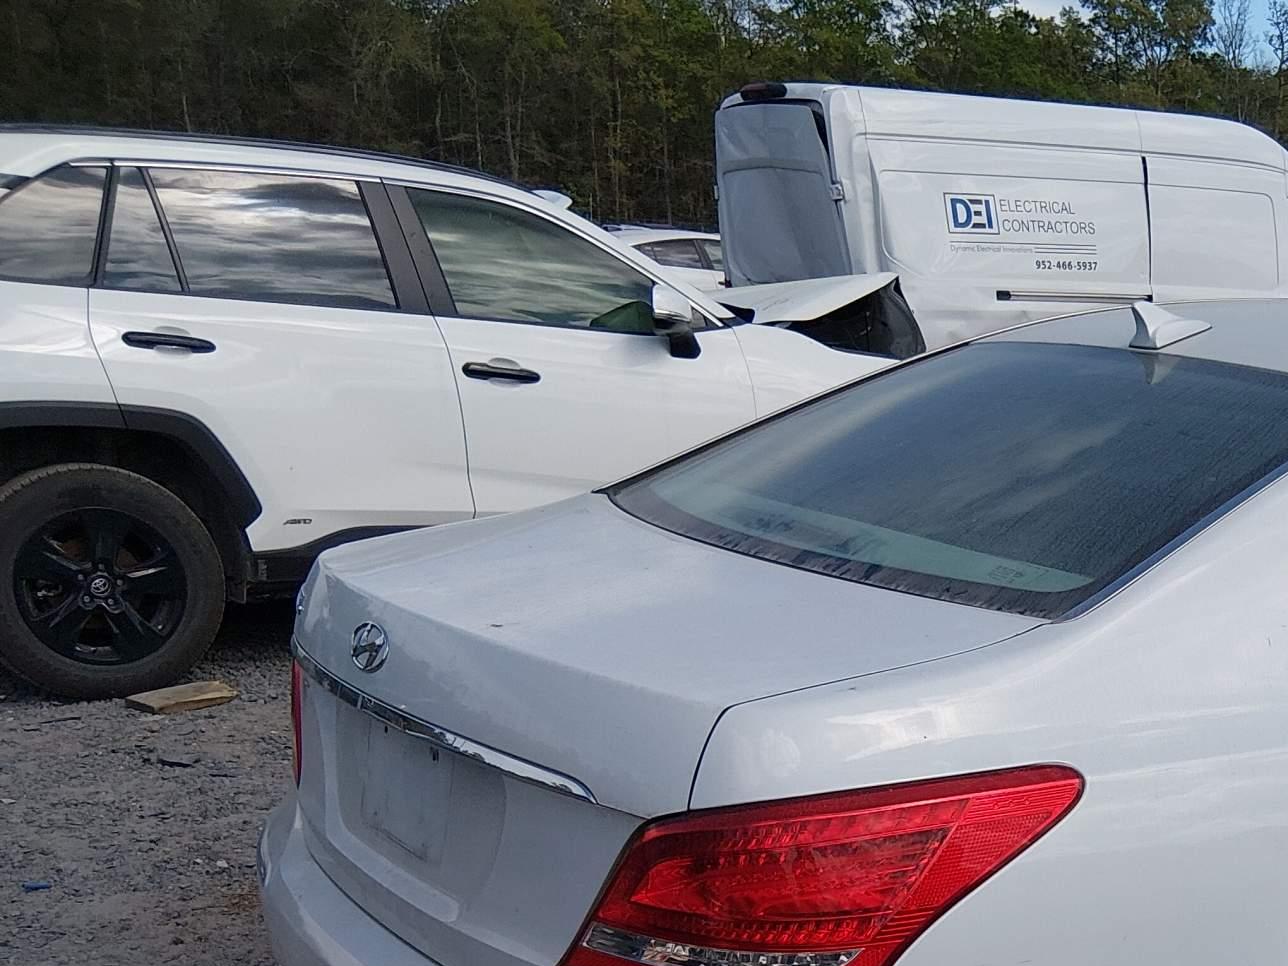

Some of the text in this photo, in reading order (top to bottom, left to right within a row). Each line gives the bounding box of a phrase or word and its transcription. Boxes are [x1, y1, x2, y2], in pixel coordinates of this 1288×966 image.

[950, 198, 994, 230] DEI
[1000, 199, 1076, 215] ELECTRICAL
[1002, 219, 1096, 235] CONTRACTORS
[1035, 260, 1098, 271] 952-466-5937
